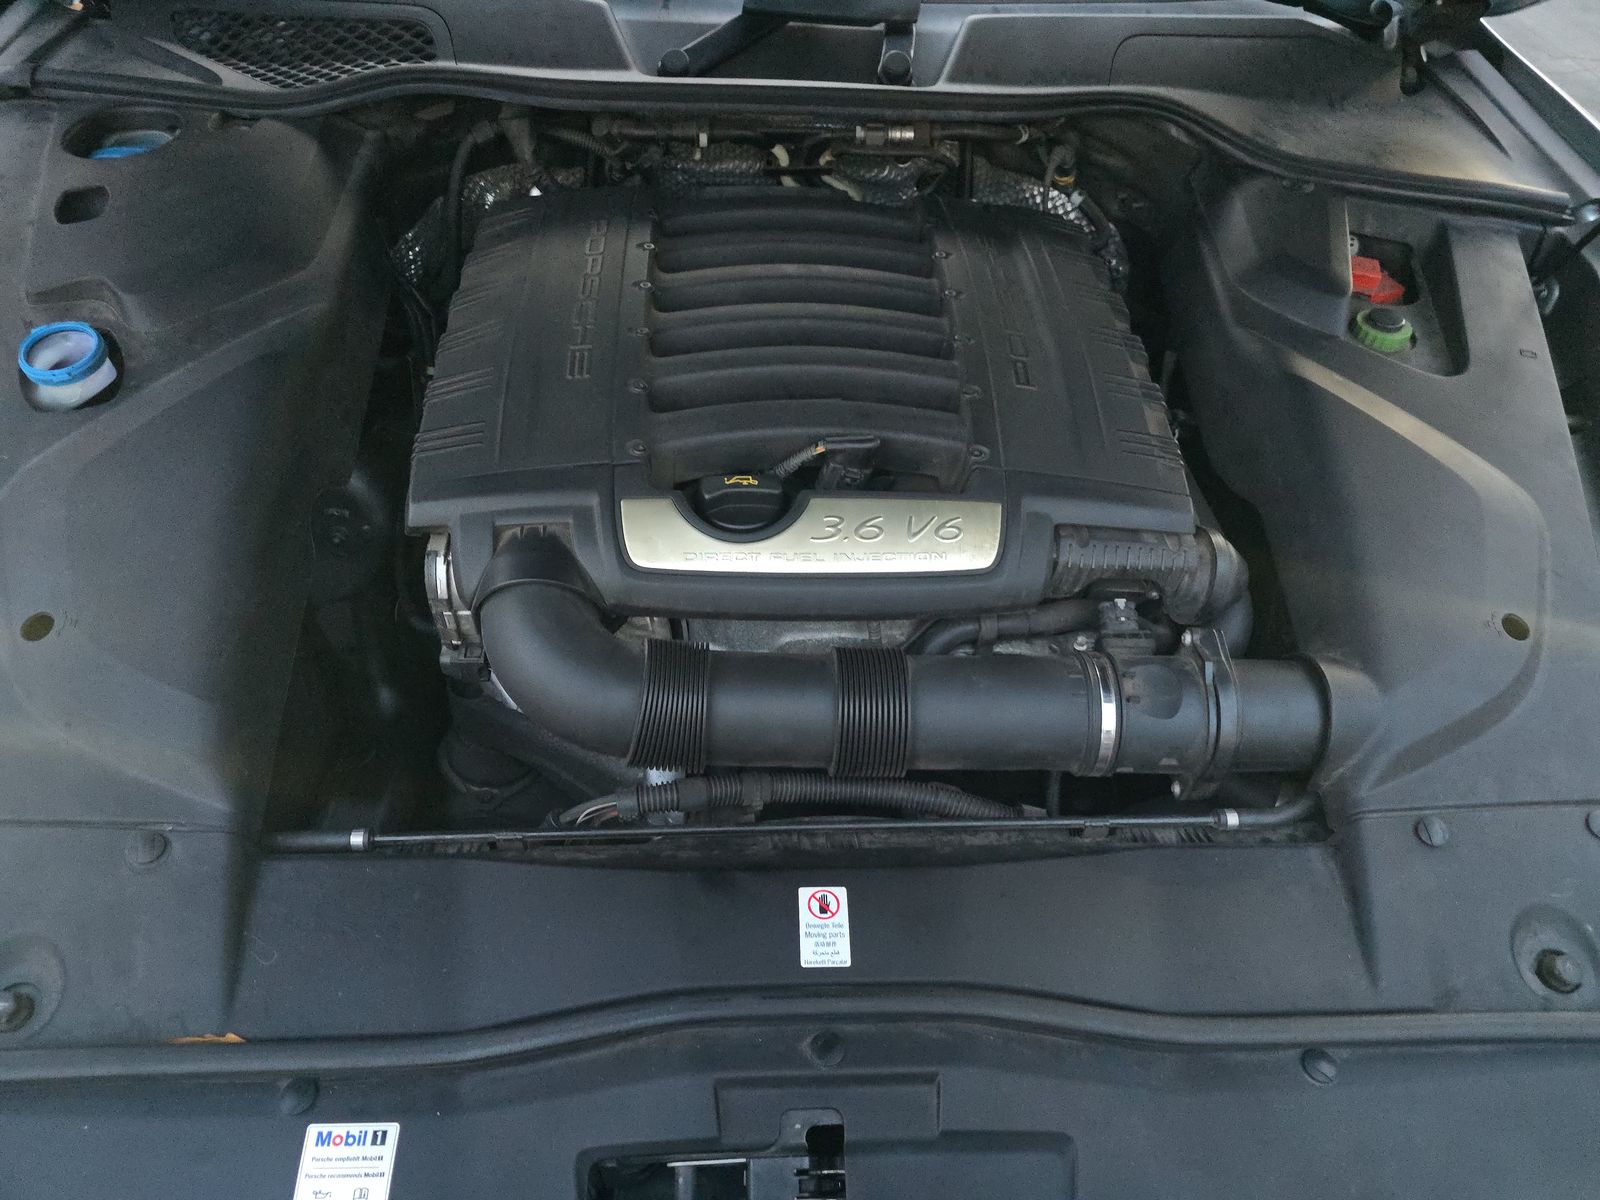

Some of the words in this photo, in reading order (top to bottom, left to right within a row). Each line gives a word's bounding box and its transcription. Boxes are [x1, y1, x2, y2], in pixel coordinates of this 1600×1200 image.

[566, 219, 609, 380] PORSCHE
[810, 515, 885, 543] 3.6
[907, 515, 964, 543] V6
[684, 551, 761, 562] DIRECT
[769, 551, 825, 562] FUEL
[833, 551, 948, 562] INJECTION
[805, 931, 828, 940] Moving
[315, 1130, 368, 1147] Mobil
